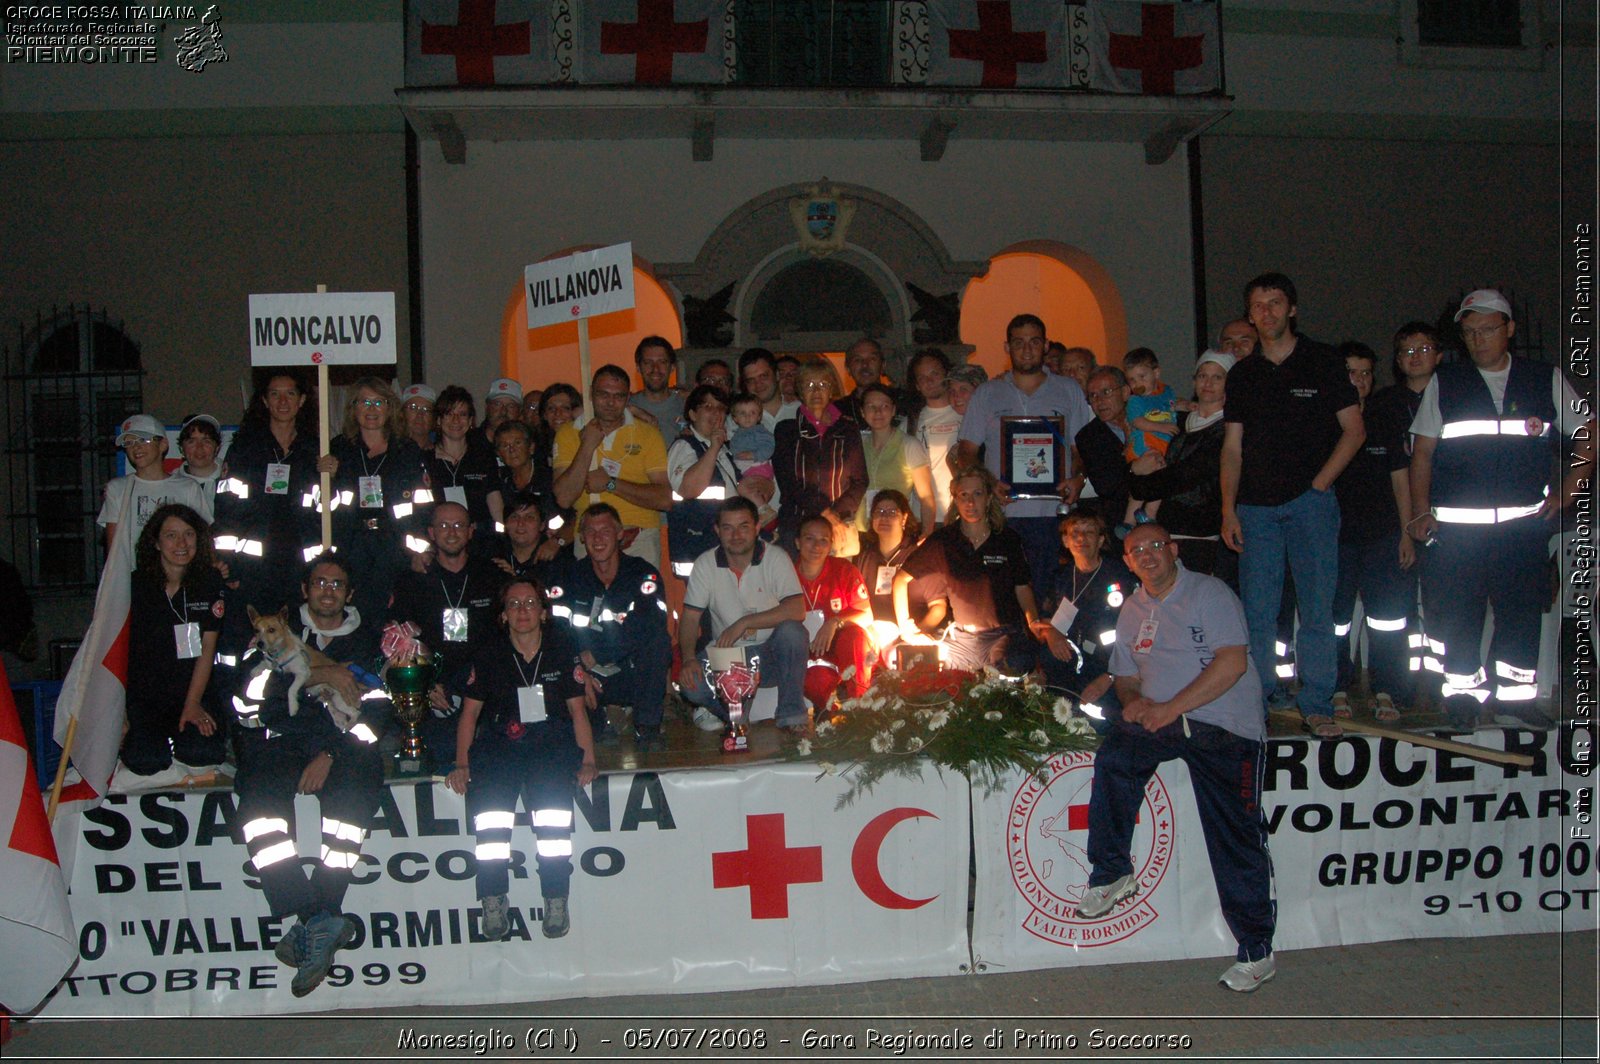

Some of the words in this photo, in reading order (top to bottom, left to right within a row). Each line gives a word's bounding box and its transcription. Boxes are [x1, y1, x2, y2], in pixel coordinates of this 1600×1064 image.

[529, 264, 623, 308] VILLANOVA
[254, 314, 382, 346] MONCALVO
[94, 861, 222, 894] DEL
[1318, 846, 1503, 887] GRUPPO
[1033, 915, 1078, 940] VALLE
[1082, 907, 1150, 941] BORMIDA
[61, 965, 278, 997] TTOBRE
[327, 962, 427, 987] 999
